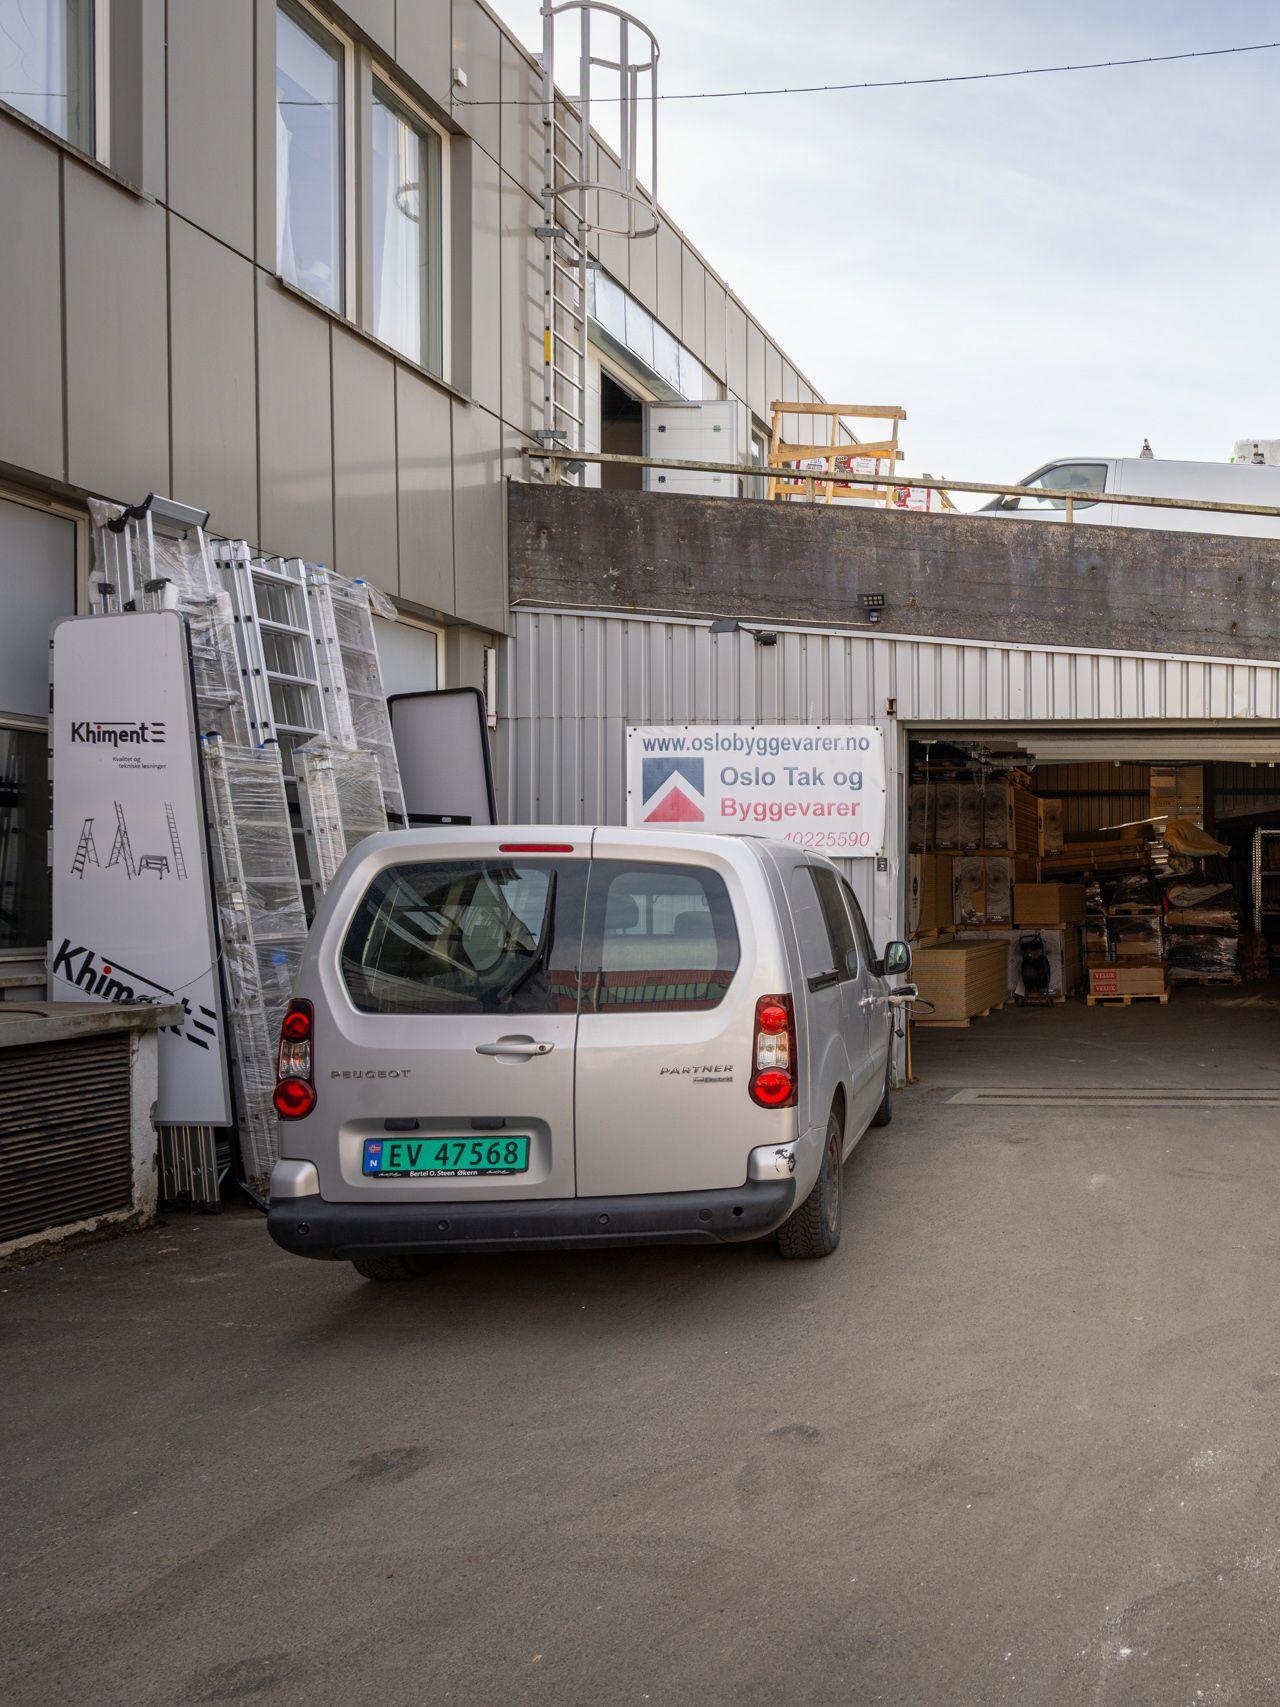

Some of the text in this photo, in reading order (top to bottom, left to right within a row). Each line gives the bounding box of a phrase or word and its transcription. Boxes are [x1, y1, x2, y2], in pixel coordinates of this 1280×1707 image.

[71, 722, 150, 747] Khiment
[642, 732, 870, 756] www.oslobyggevarer.no
[720, 766, 863, 791] Oslo Tak og
[720, 797, 861, 822] Byggevarer
[330, 1070, 411, 1079] PEUGEOT
[660, 1064, 733, 1075] PARTNER
[389, 1141, 519, 1168] EV 47568
